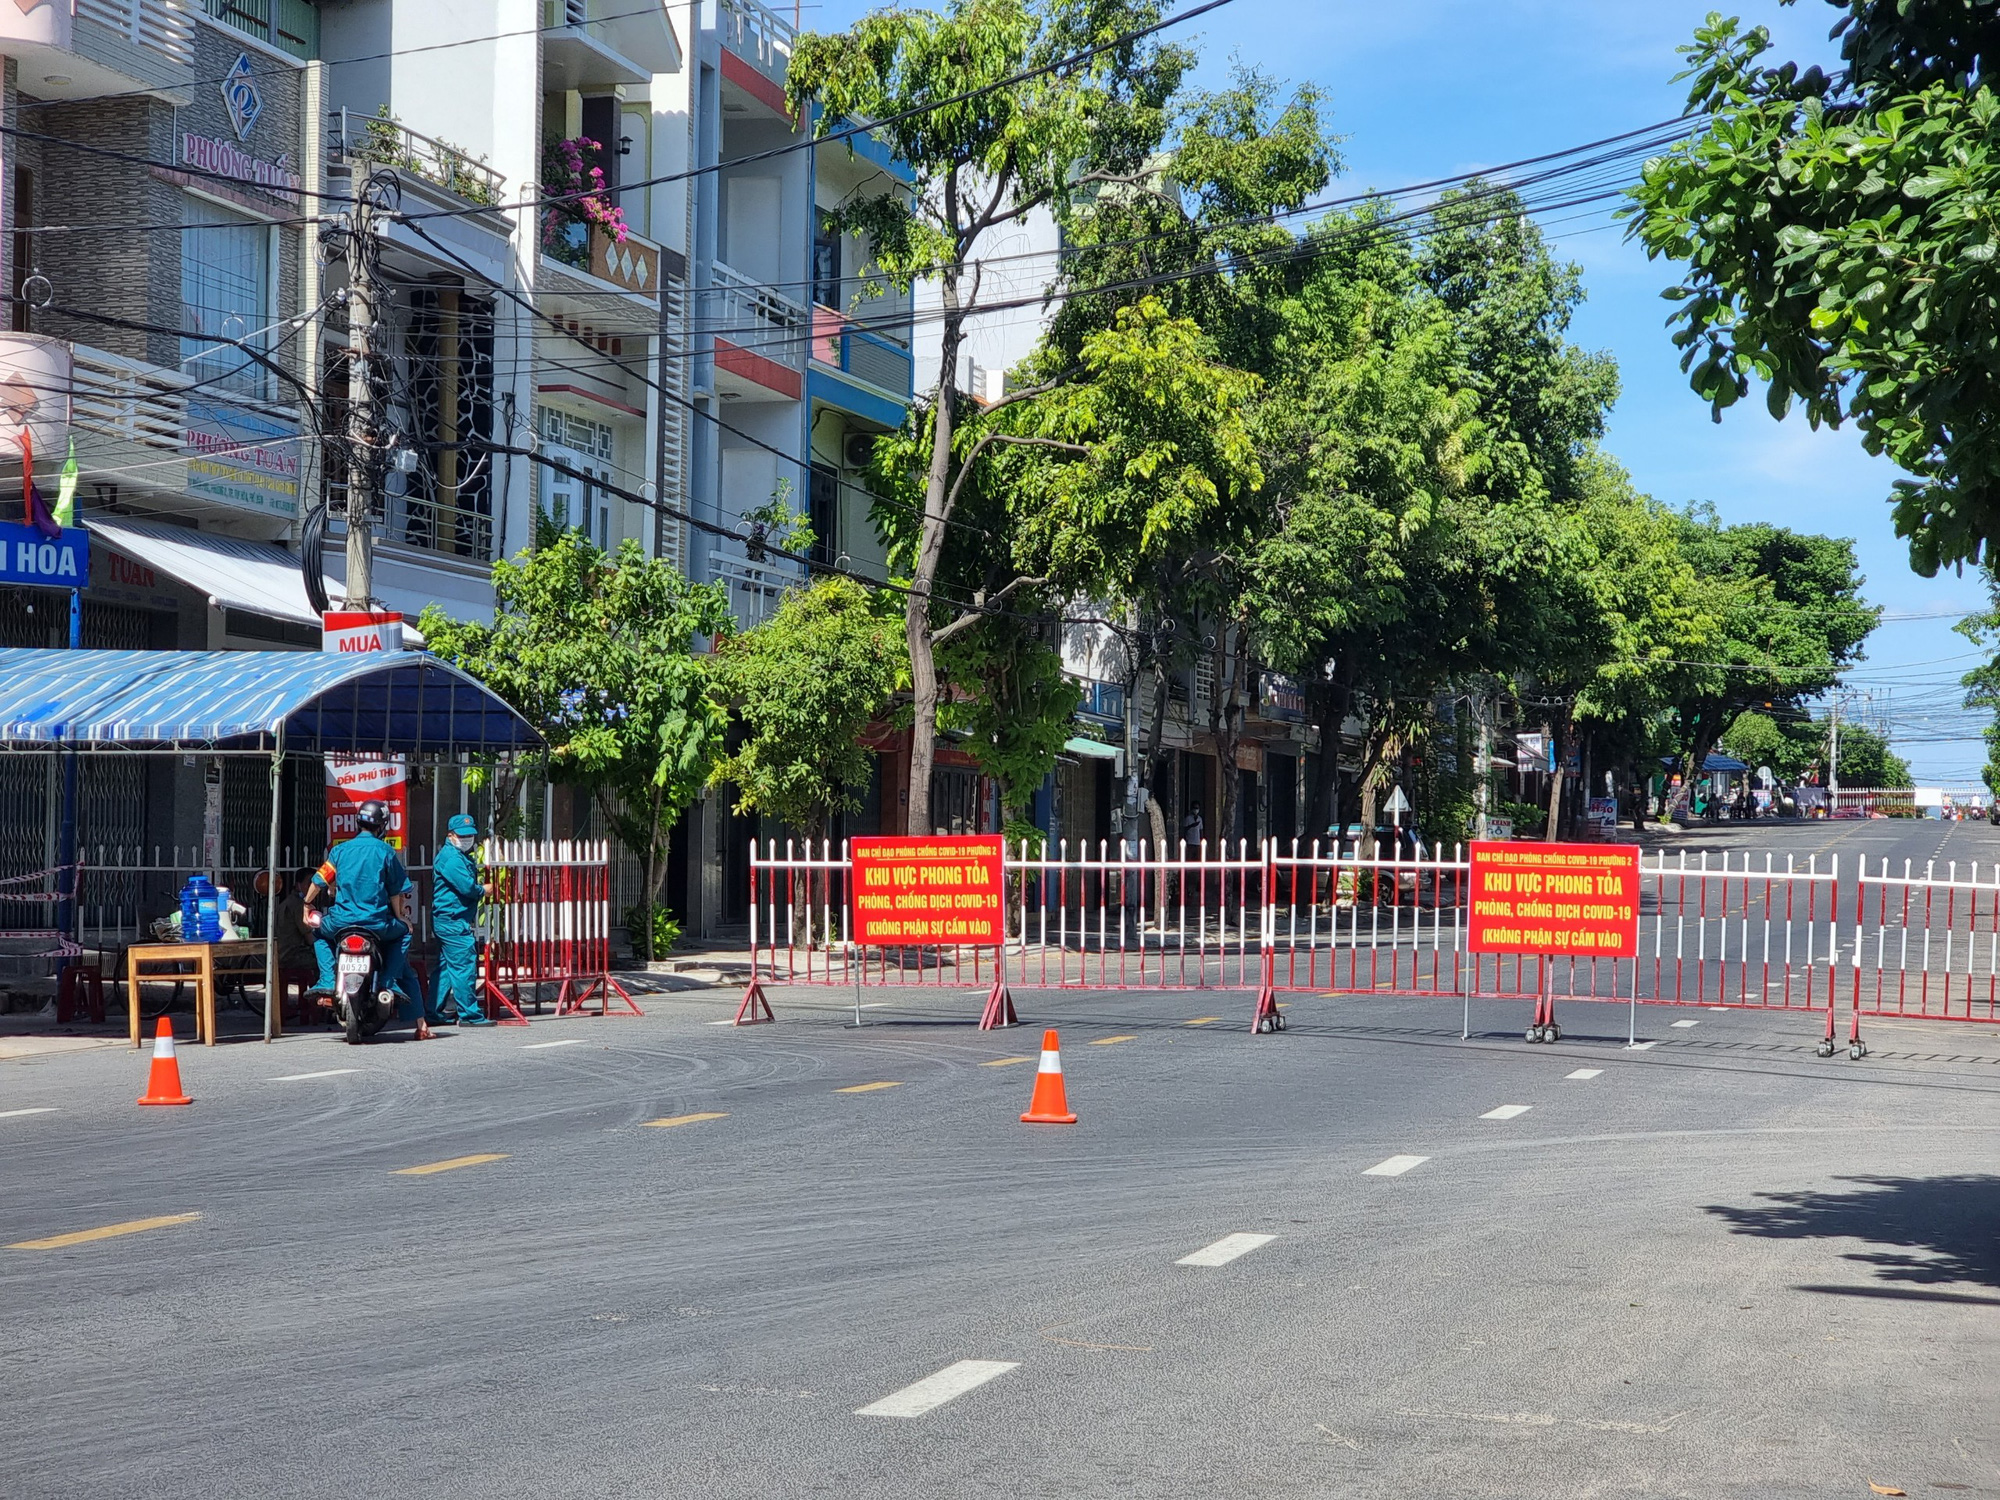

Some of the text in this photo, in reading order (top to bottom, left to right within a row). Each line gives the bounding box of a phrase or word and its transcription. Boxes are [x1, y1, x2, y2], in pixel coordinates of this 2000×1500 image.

[183, 133, 253, 181] PHƯƠNG
[187, 429, 297, 475] PHƯƠNG TUẤN
[17, 537, 77, 577] HÓA
[339, 634, 382, 652] MUA
[337, 767, 397, 785] ĐẾN PHÚ THU
[332, 814, 358, 832] PH
[858, 844, 996, 859] BAN CHỈ ĐẠO PHÒNG CHỐNG COVID-19 PHƯỜNG 2
[1477, 850, 1632, 866] BAN CHỈ ĐẠO PHÒNG CHỐNG COVID-19 PHƯỜNG 2
[866, 860, 988, 889] KHU VỰC PHONG TỎA
[1484, 870, 1622, 896] KHU VỰC PHONG TỎA
[859, 890, 997, 911] PHÒNG, CHỐNG DỊCH COVID-19
[1475, 898, 1631, 921] PHÒNG, CHỐNG DỊCH COVID-19
[867, 916, 991, 937] (KHÔNG PHẬN SỰ CẤM VÀO)
[1483, 926, 1621, 949] (KHÔNG PHẬN SỰ CẤM VÀO)
